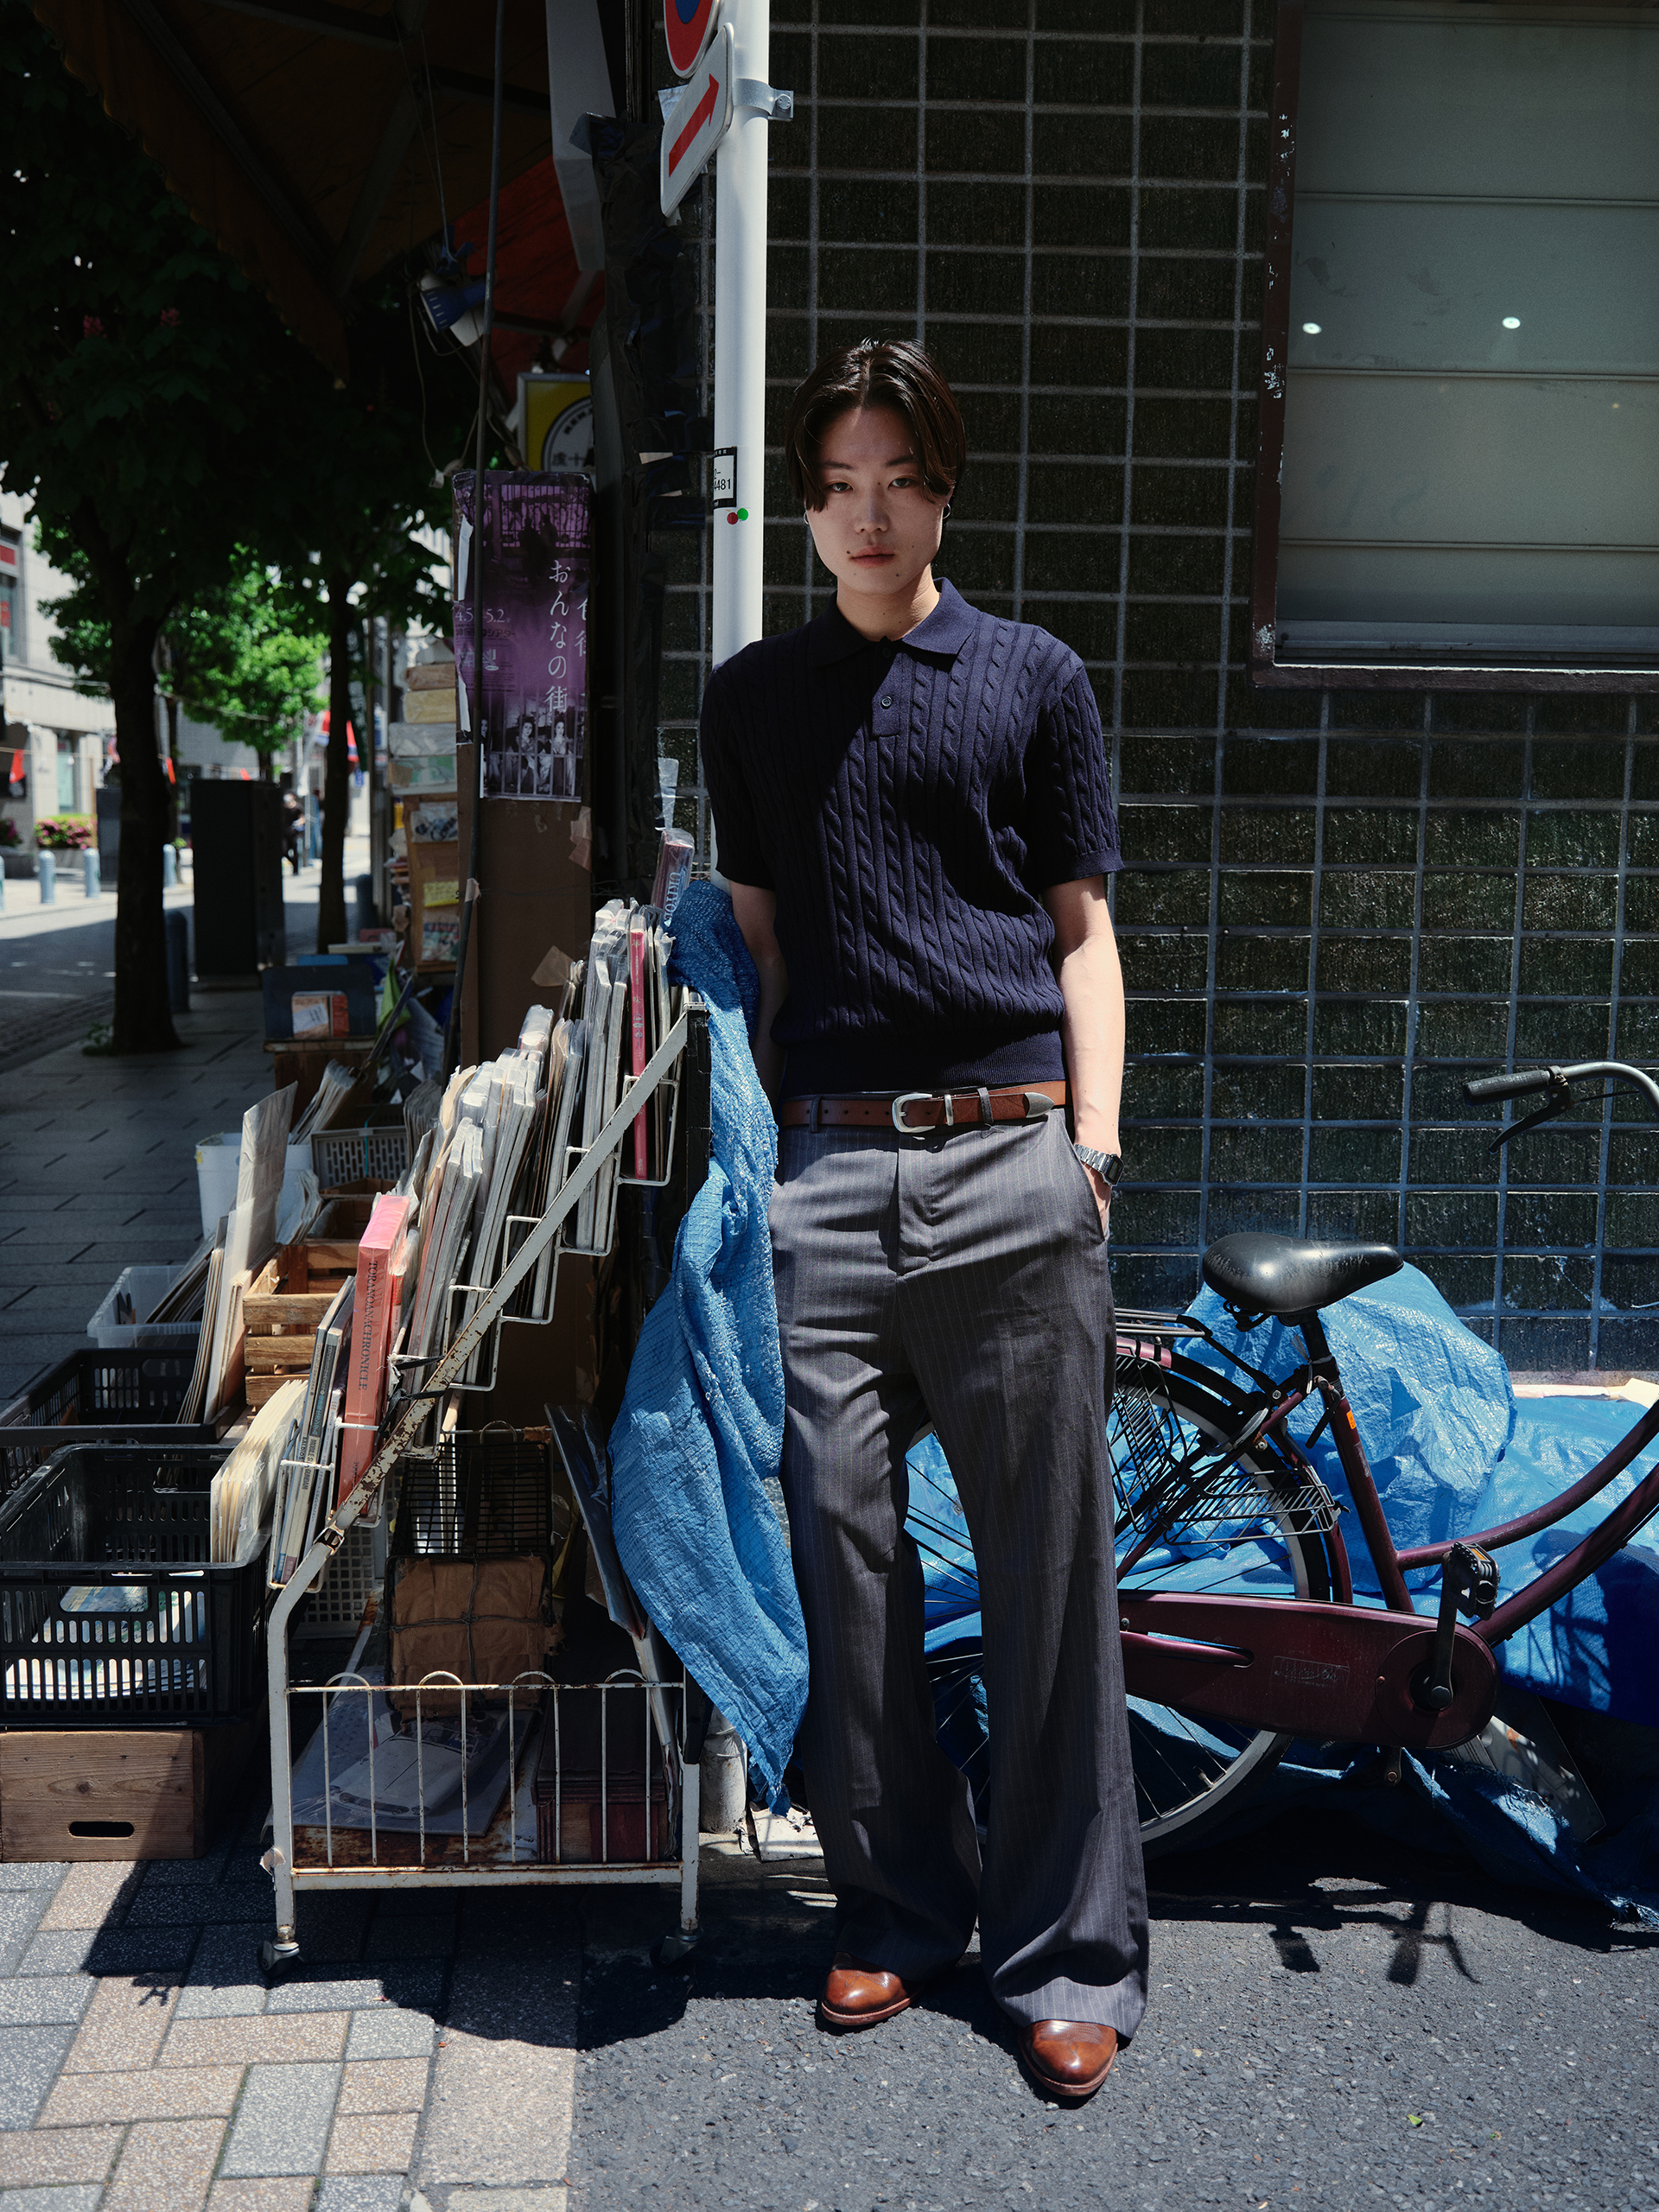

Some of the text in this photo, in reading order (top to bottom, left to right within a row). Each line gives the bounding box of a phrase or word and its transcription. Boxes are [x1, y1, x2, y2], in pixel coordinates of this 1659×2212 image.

[544, 559, 571, 713] おんなの街
[358, 1260, 378, 1391] TORANOANACHRONICLE
